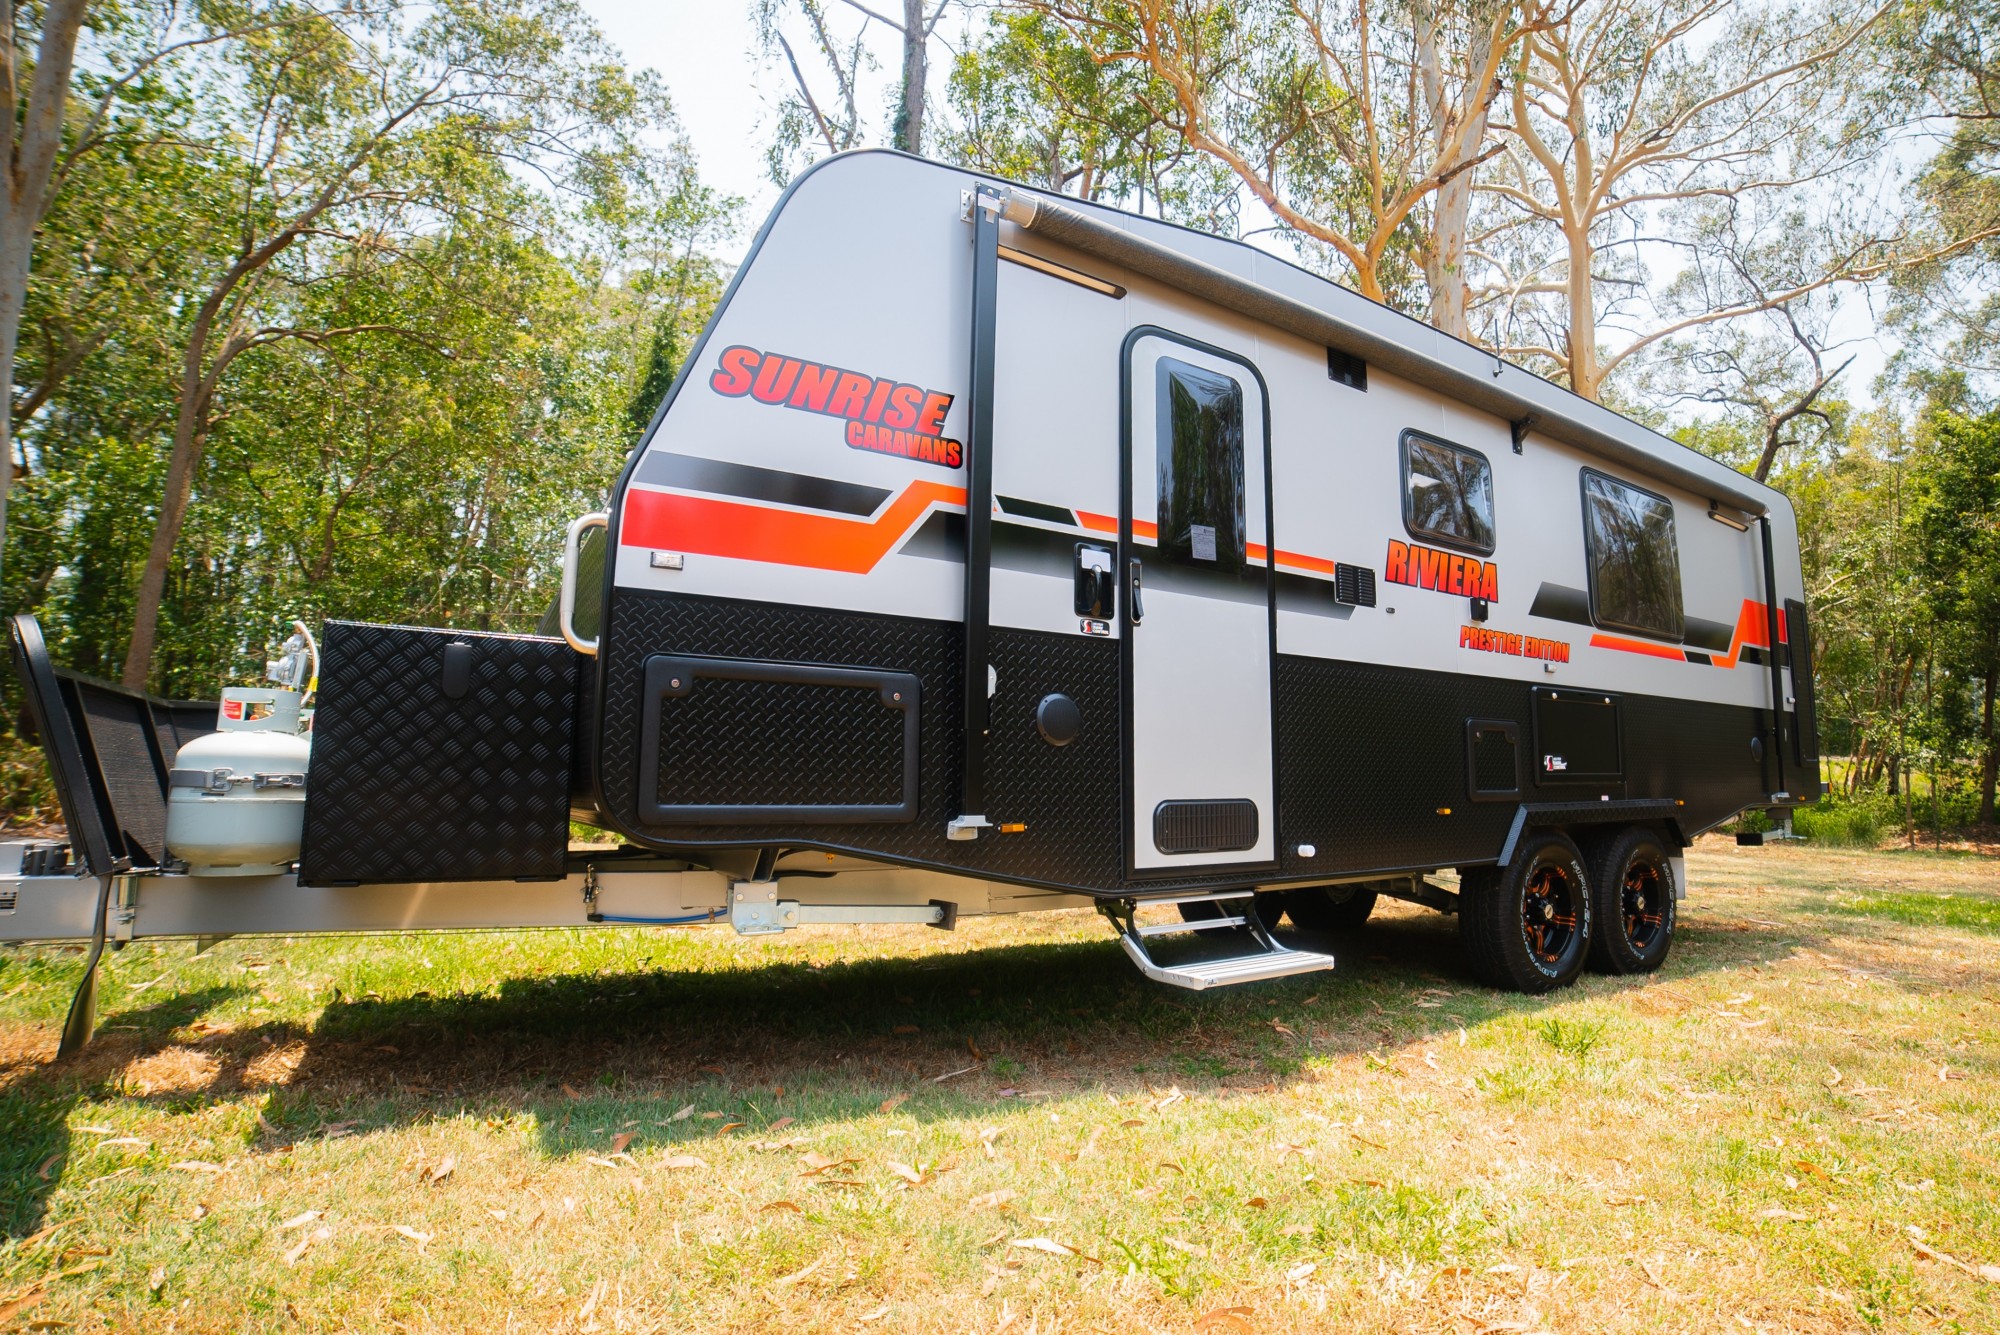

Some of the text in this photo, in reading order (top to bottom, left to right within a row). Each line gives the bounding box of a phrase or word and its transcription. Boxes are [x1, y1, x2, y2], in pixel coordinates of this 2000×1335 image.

[709, 345, 955, 437] SUNRISE
[845, 420, 963, 469] CARAVANS
[1385, 538, 1499, 603] RIVIERA
[1459, 625, 1570, 663] PRESTIGE EDITION
